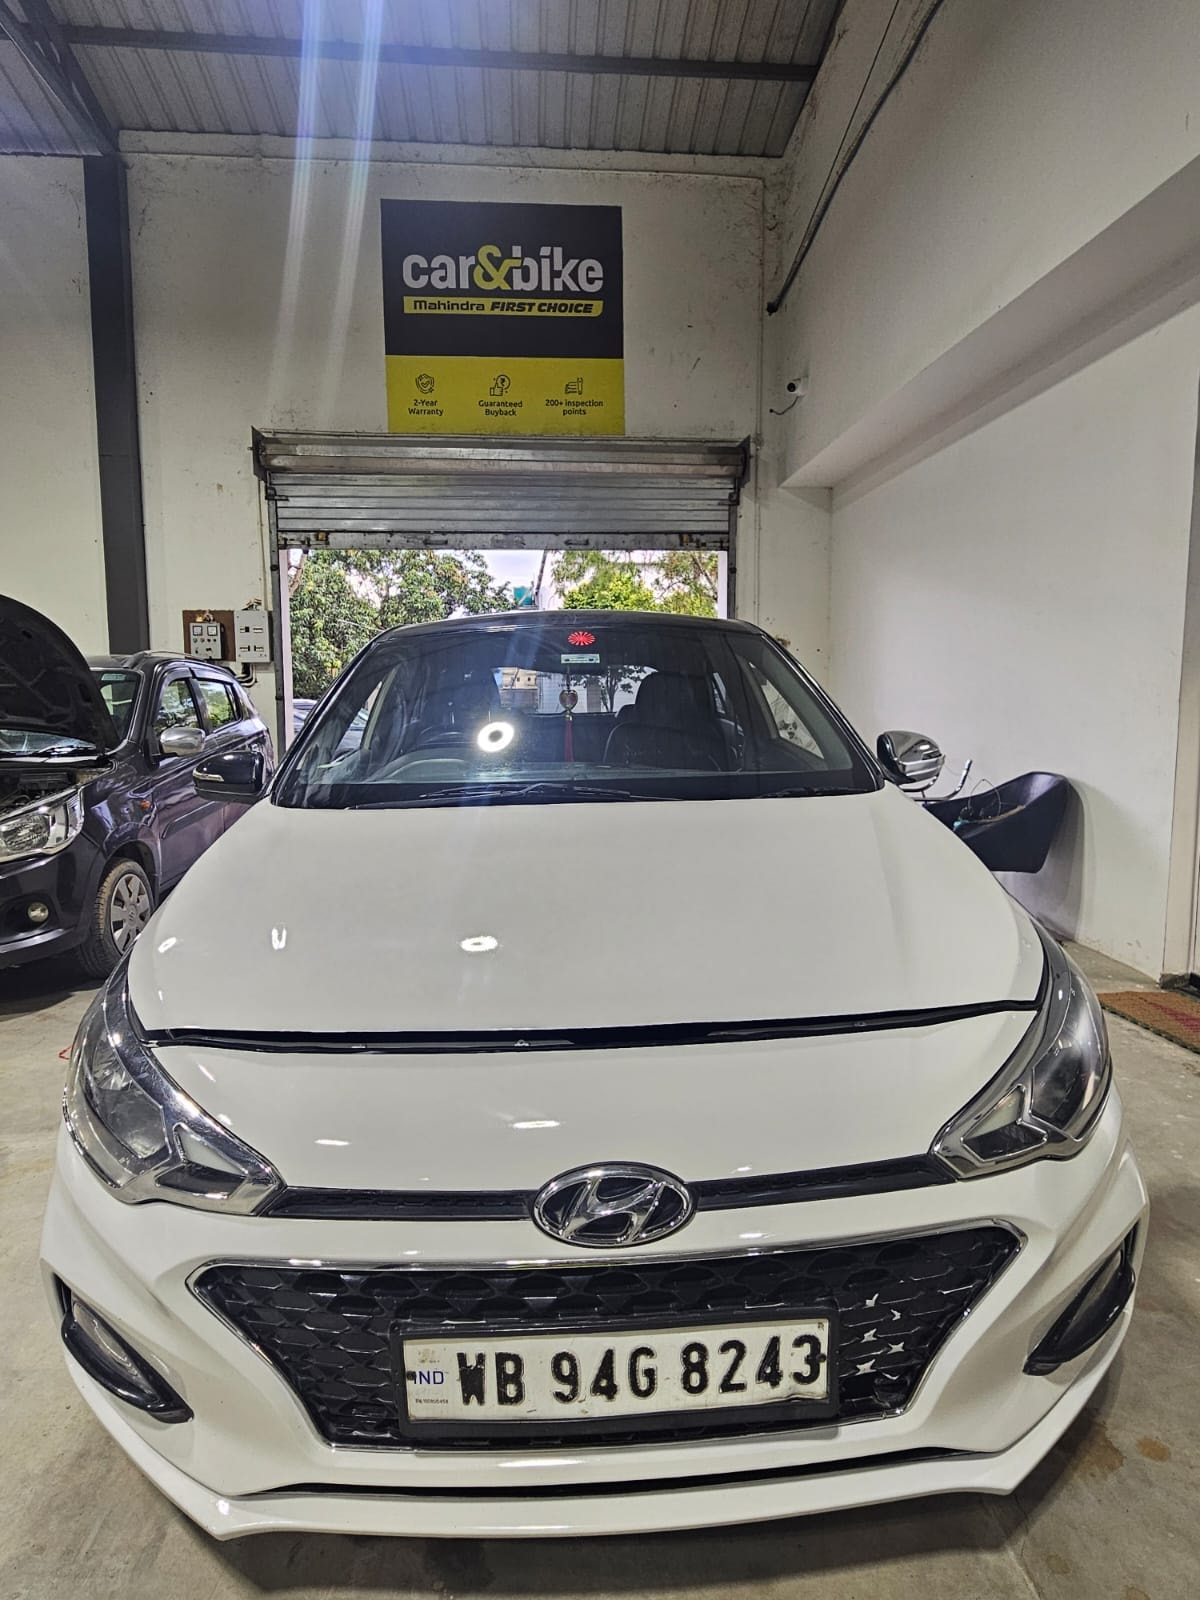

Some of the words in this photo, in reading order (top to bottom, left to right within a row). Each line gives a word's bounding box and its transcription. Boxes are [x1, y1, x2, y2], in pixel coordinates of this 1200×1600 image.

[402, 244, 604, 293] car&bike
[413, 300, 485, 311] Mahindra
[490, 302, 536, 312] FIRST
[537, 302, 594, 313] CHOICE
[413, 399, 438, 408] 2-Year
[478, 400, 523, 408] Guaranteed
[545, 399, 563, 407] 200+
[564, 399, 604, 409] inspection
[408, 407, 444, 416] Warranty
[484, 408, 517, 417] Buyback
[562, 407, 587, 416] points
[456, 1352, 525, 1407] WB
[549, 1347, 658, 1404] 94G
[681, 1334, 823, 1395] 8243
